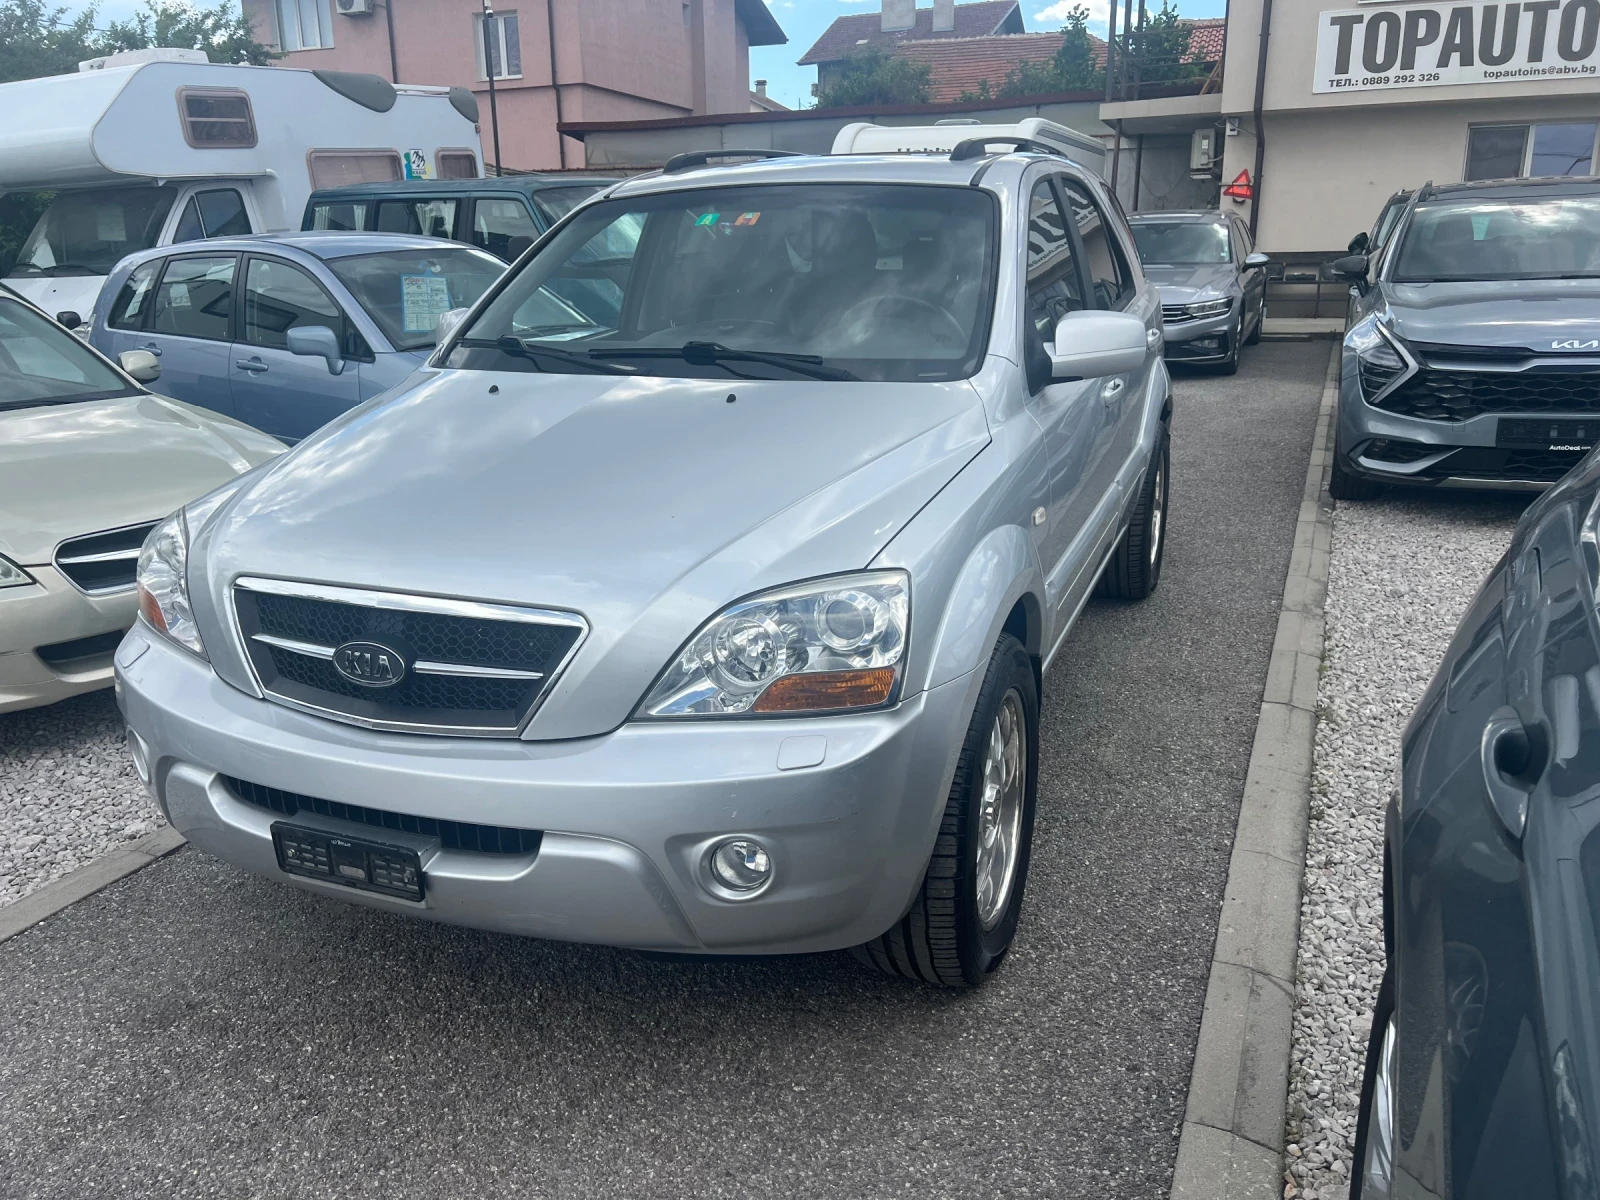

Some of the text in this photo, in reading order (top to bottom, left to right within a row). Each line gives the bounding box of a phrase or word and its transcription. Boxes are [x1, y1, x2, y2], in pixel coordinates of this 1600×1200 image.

[1330, 0, 1600, 75] TOPAUTO
[1328, 72, 1441, 88] ТЕЛ.: 0889 292 326
[1483, 64, 1597, 80] topautoins@abv.bg
[345, 650, 393, 678] KIA
